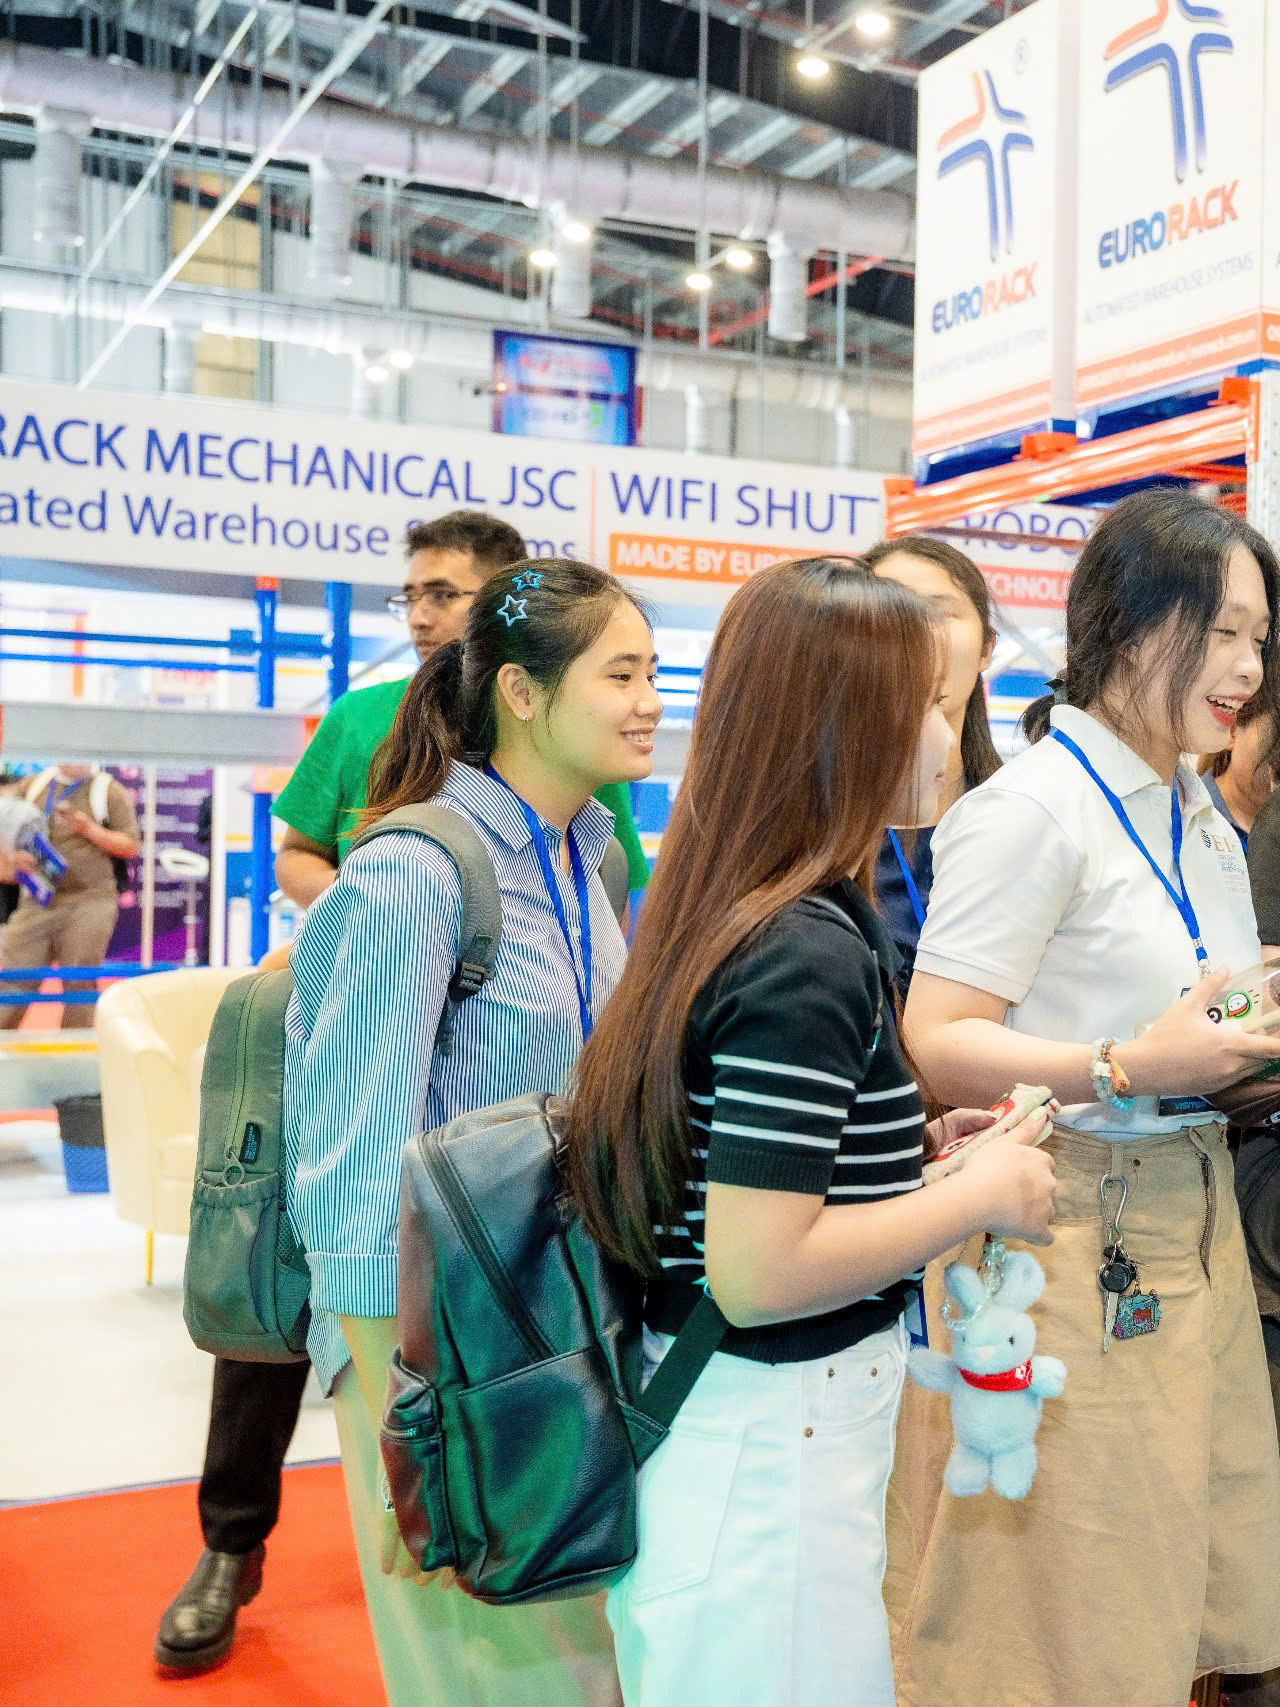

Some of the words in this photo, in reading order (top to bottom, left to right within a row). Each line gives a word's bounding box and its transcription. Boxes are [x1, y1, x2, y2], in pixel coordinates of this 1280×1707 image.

[1098, 179, 1238, 269] EURORACK
[932, 262, 1038, 334] EURORACK
[0, 413, 127, 471] ACK
[145, 427, 487, 504] MECHANICAL
[498, 465, 577, 512] JSC
[610, 471, 718, 524] WIFI
[963, 510, 1094, 557] ROBO
[124, 493, 390, 556] Warehouse
[616, 540, 690, 572] MADE
[694, 547, 729, 574] BY
